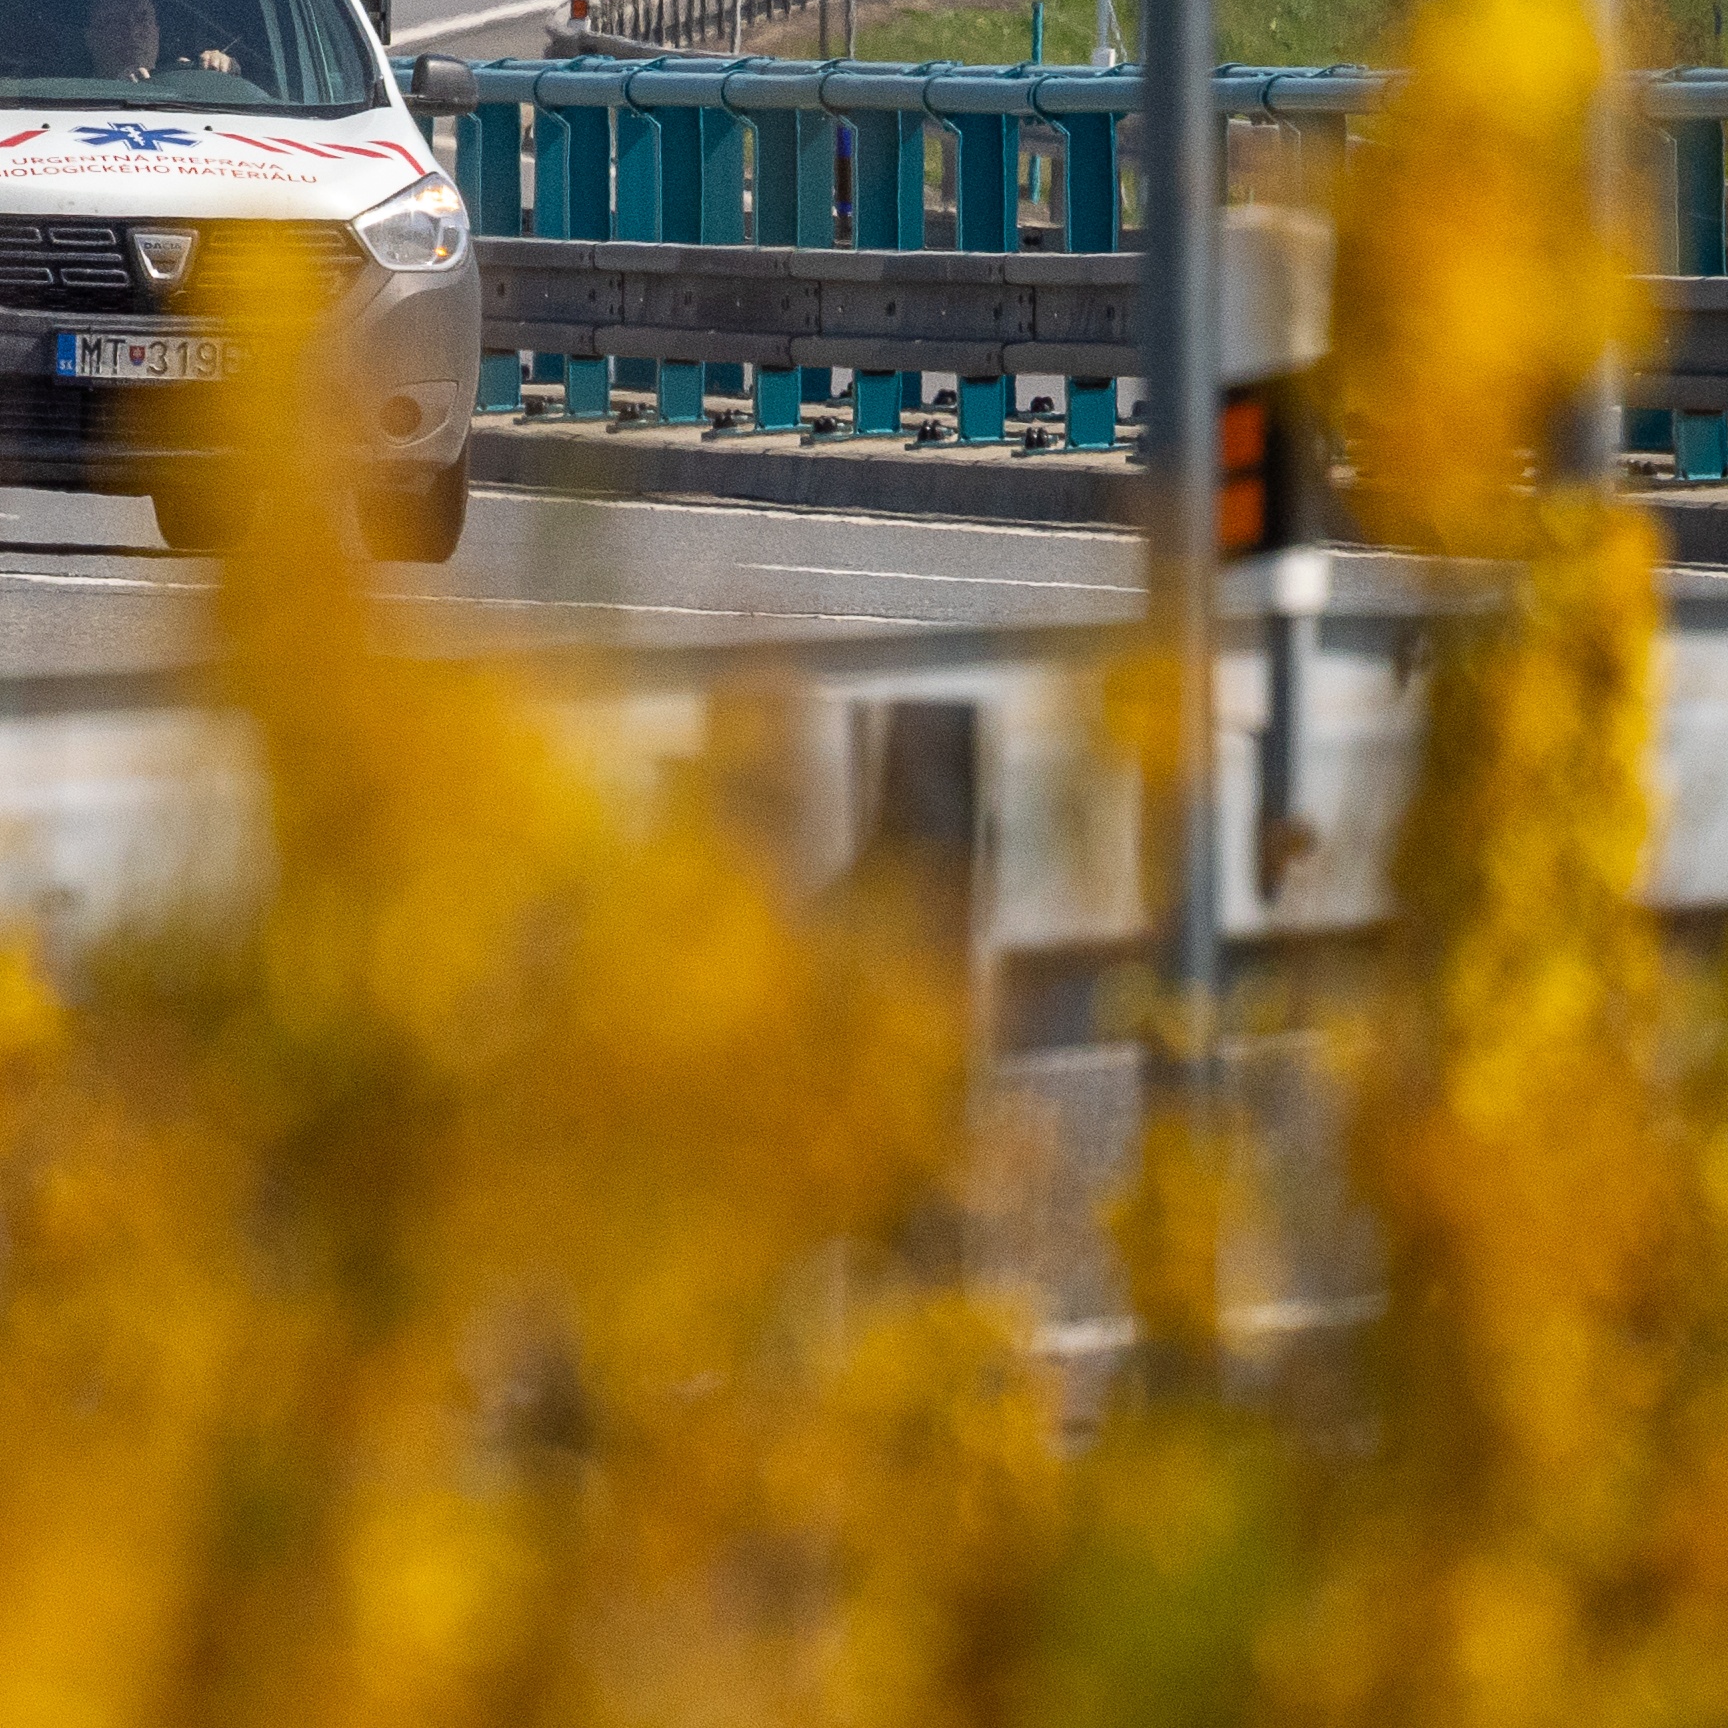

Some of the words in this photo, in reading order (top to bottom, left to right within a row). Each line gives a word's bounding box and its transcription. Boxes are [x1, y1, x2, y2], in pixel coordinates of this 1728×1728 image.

[156, 155, 284, 171] PREPRAVA
[144, 241, 182, 250] DACIA
[81, 337, 126, 374] MT
